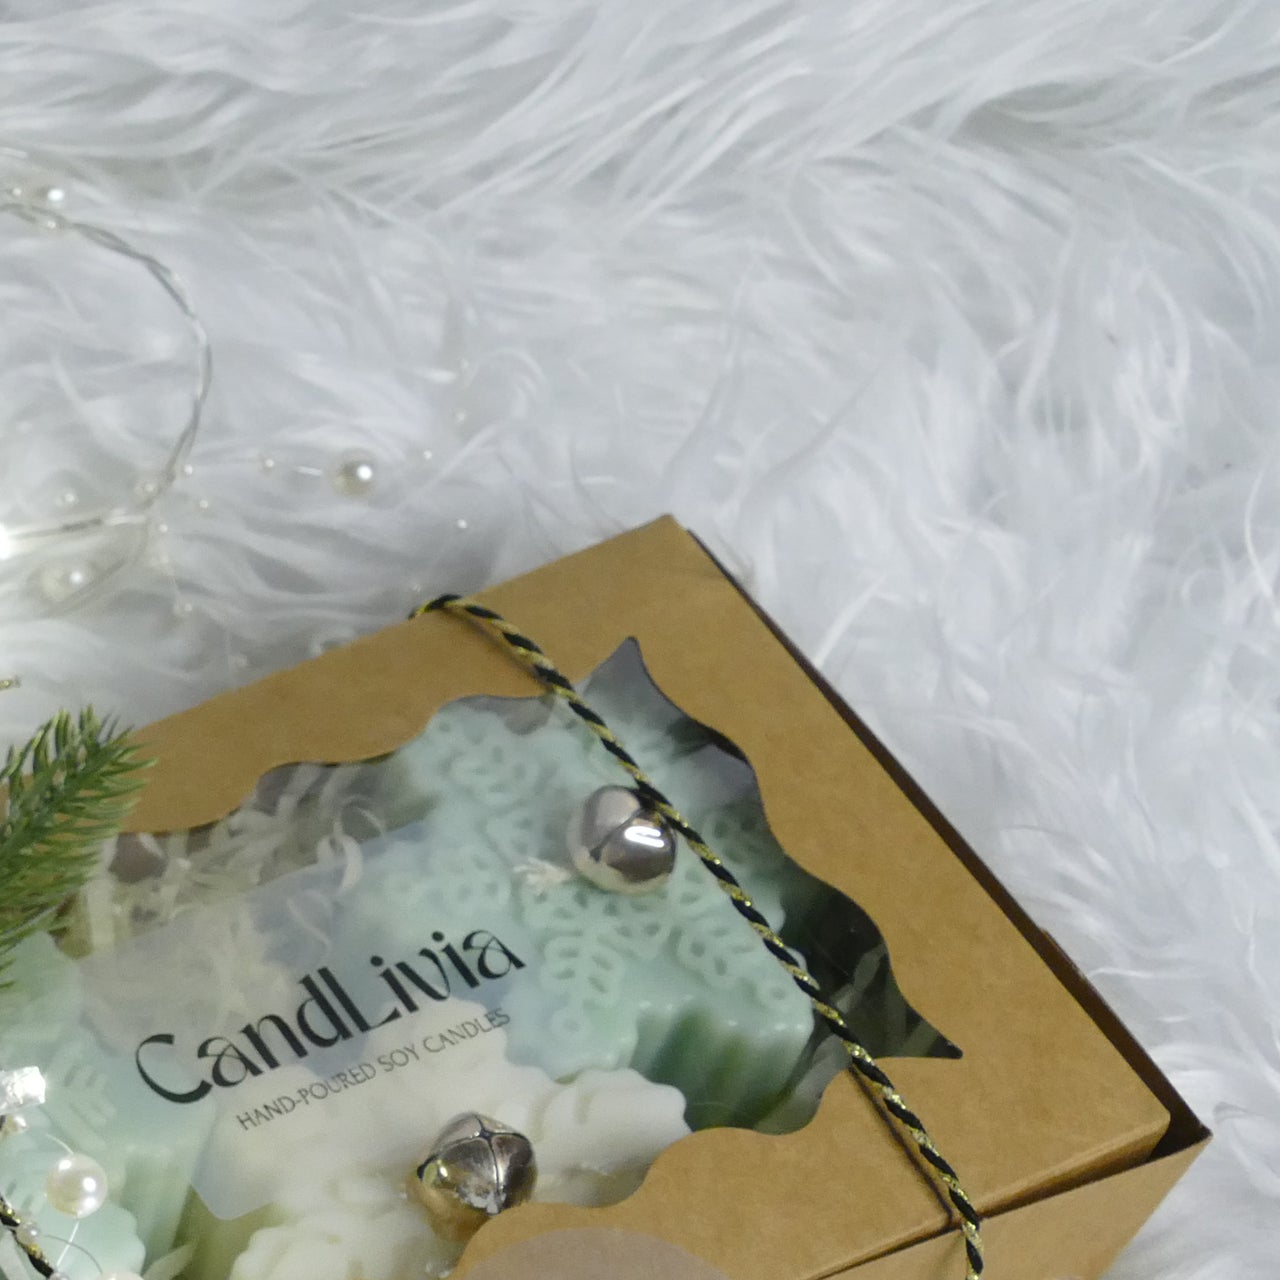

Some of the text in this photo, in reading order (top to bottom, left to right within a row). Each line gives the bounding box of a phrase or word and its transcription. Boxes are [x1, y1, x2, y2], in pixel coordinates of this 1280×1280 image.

[135, 929, 527, 1104] CandLivia
[236, 1007, 512, 1131] HAND-POURED SOY CANDLES
